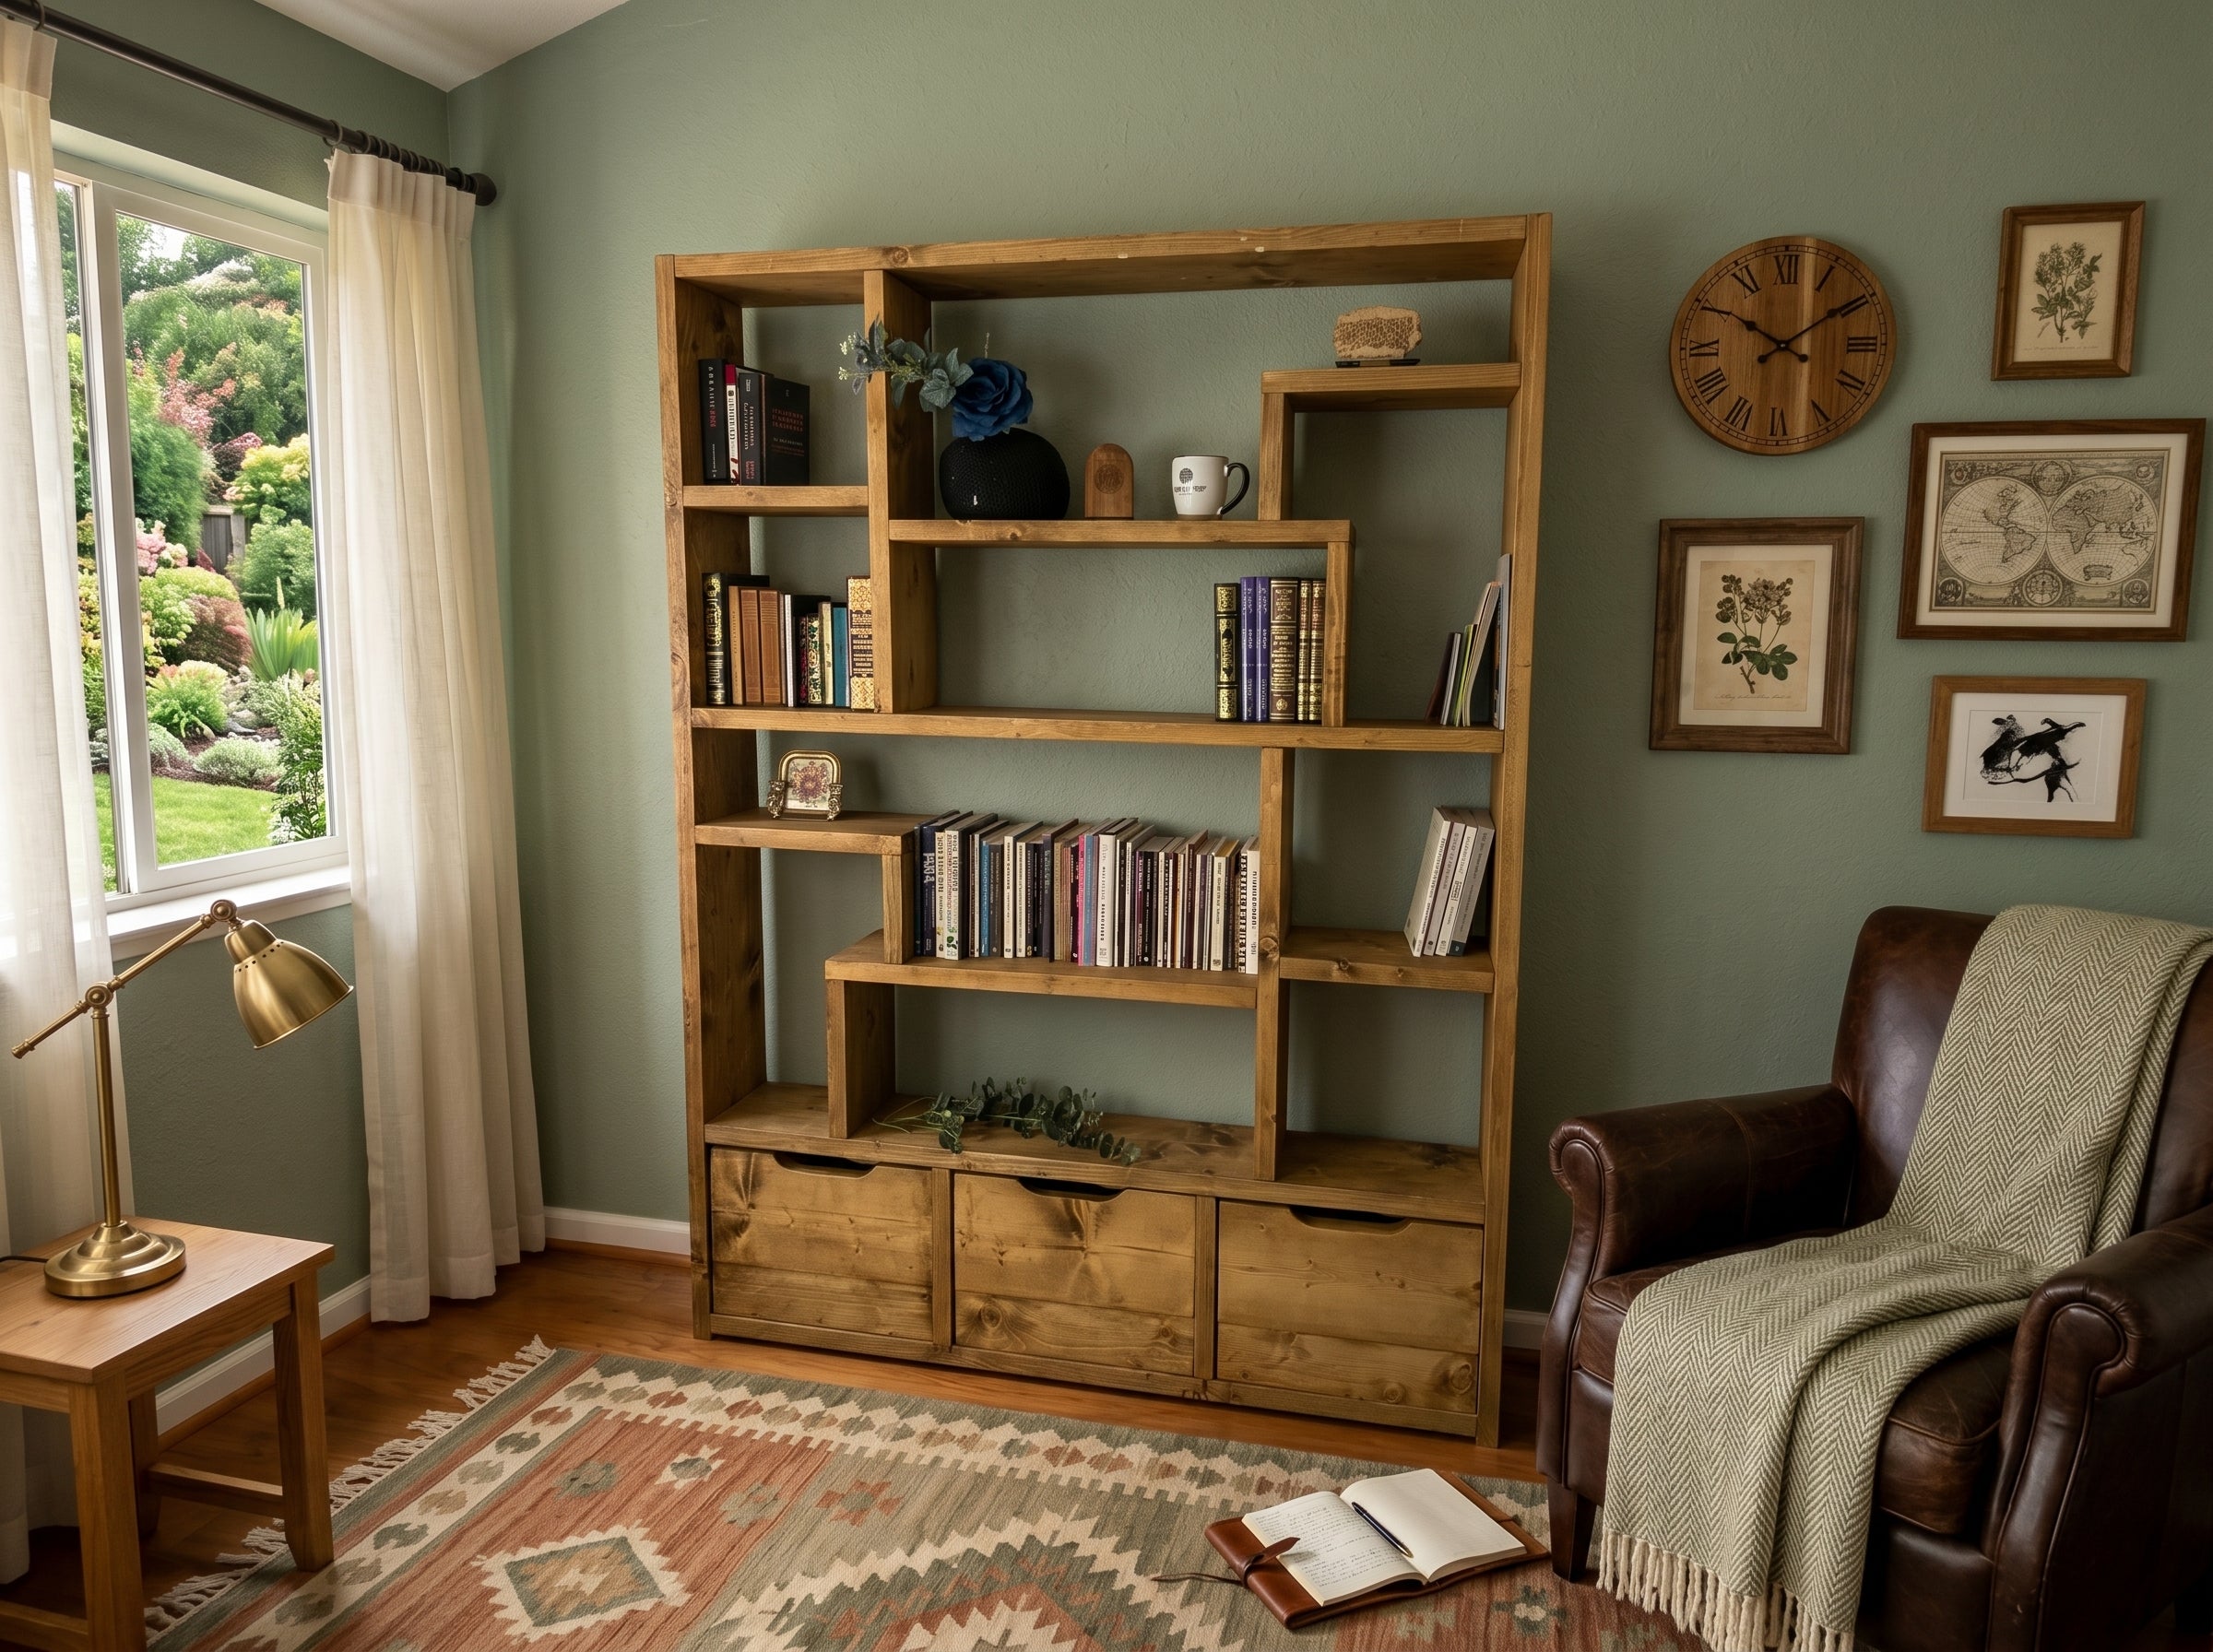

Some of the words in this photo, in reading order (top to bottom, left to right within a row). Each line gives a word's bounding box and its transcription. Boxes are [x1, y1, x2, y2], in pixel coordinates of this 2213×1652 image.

[1732, 264, 1762, 299] XI
[1773, 254, 1799, 285] XII
[1816, 265, 1835, 292] I
[1701, 299, 1732, 322] X
[1838, 294, 1869, 318] II
[1689, 339, 1719, 358] IX
[1847, 336, 1877, 354] III
[1695, 368, 1731, 405] VIII
[1836, 370, 1865, 398] IV
[1724, 395, 1754, 431] VII
[1769, 407, 1787, 436] VI
[1811, 399, 1830, 427] V
